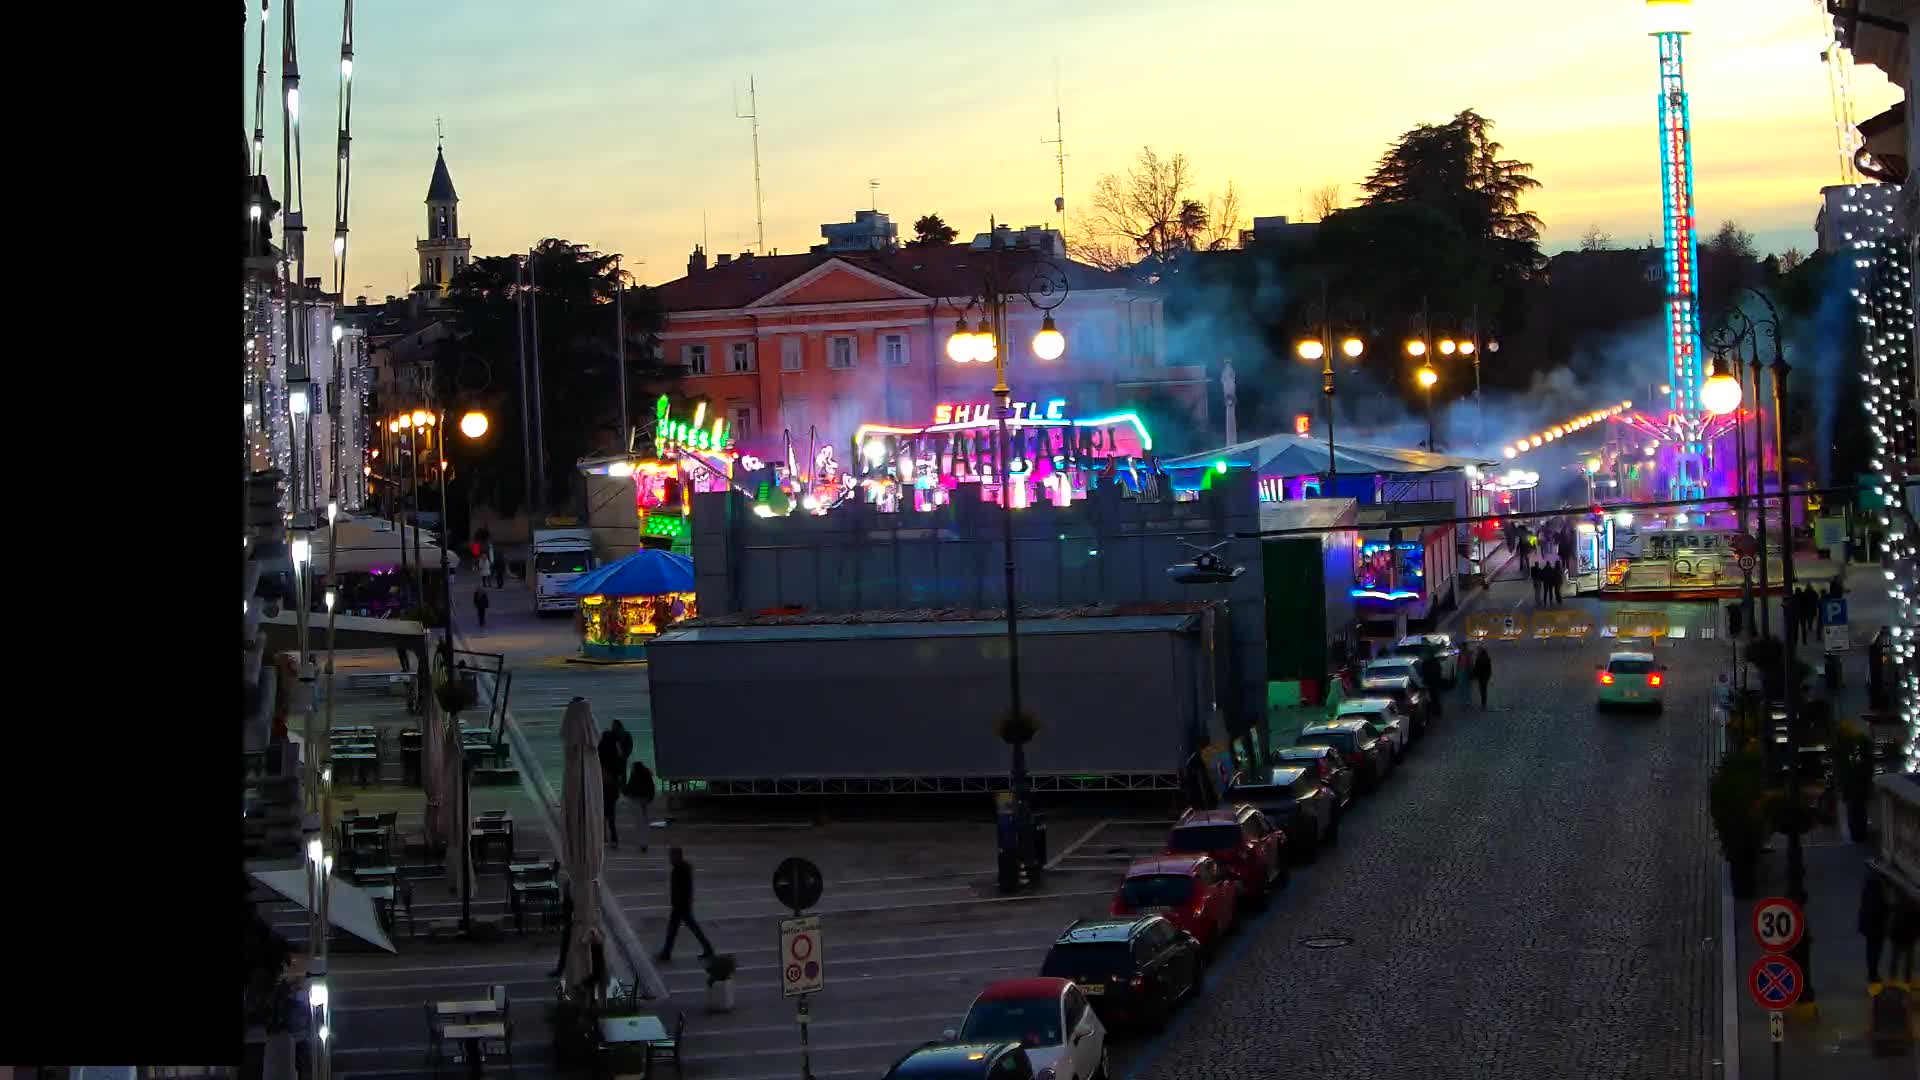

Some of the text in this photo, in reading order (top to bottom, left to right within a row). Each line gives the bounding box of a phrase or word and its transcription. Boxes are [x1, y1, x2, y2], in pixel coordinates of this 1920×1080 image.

[934, 398, 1066, 425] SHUTLE
[1742, 558, 1752, 567] 20
[1827, 602, 1841, 622] P
[1762, 911, 1791, 938] 30
